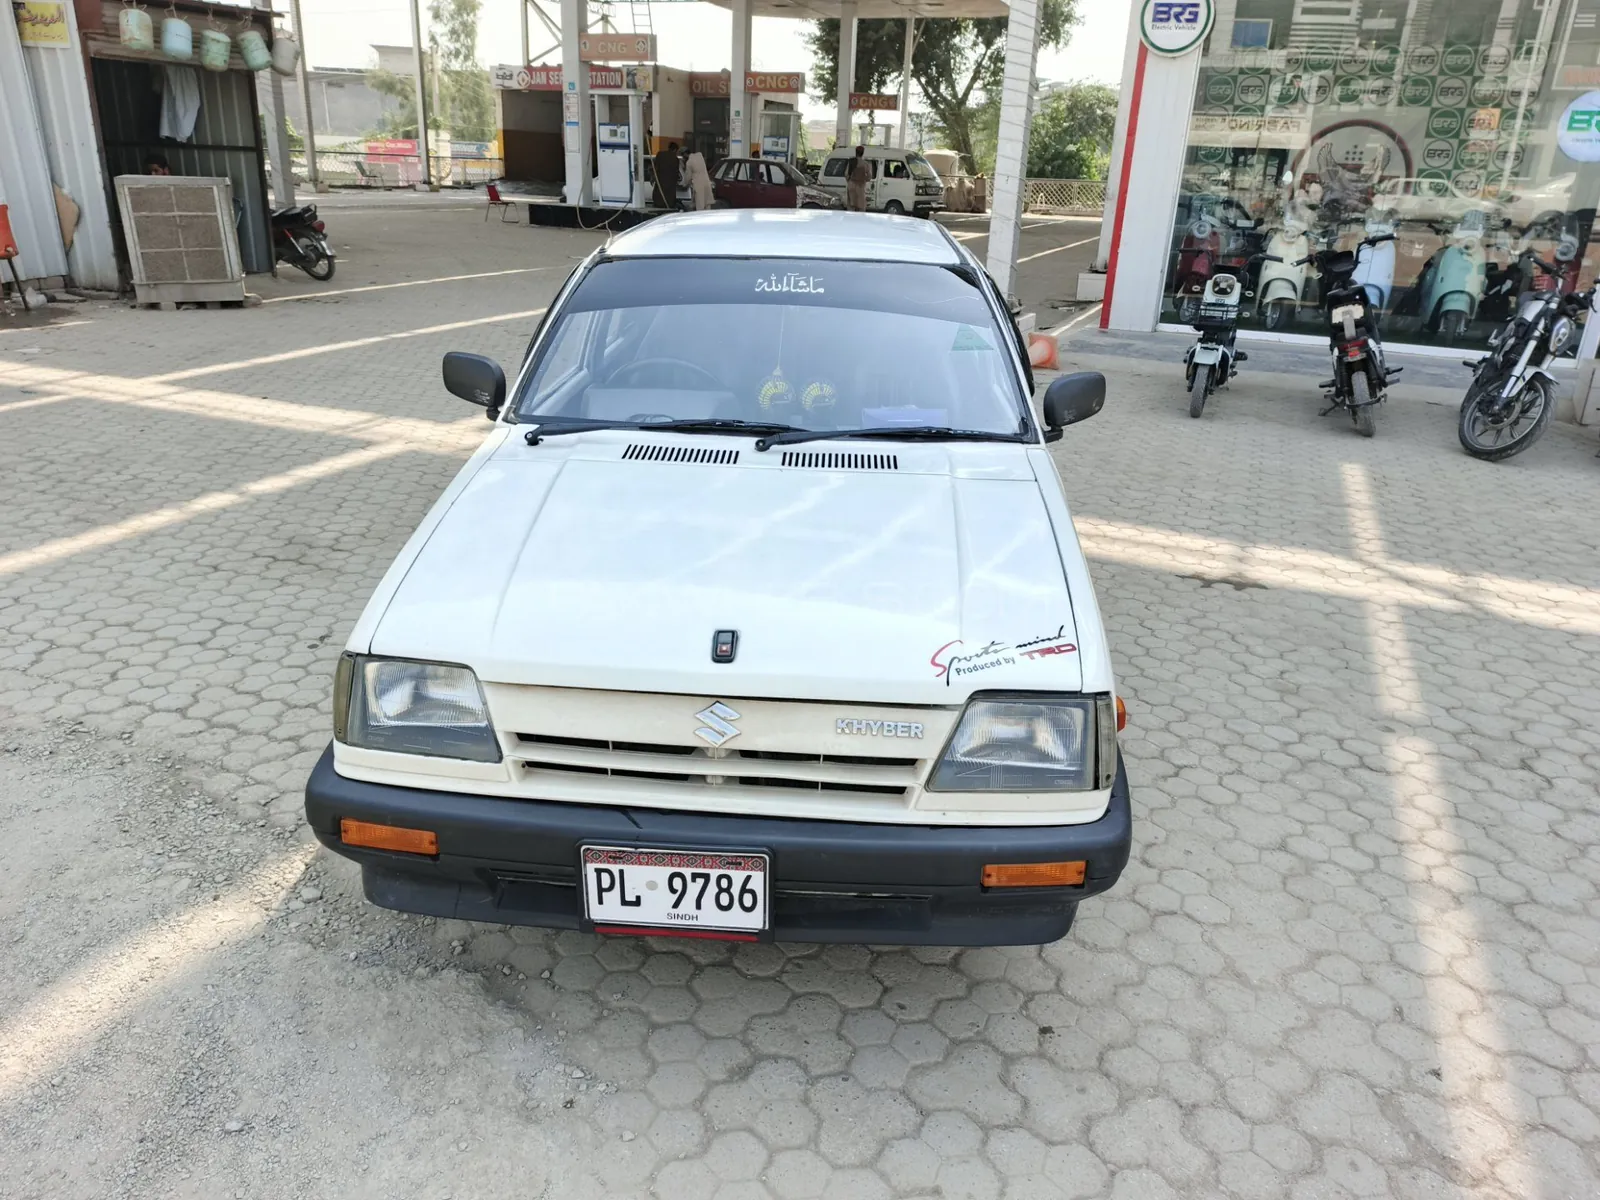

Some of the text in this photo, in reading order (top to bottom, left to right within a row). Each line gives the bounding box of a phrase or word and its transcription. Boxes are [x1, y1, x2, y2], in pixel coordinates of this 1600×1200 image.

[1152, 3, 1200, 23] BRG
[598, 42, 627, 53] CNG
[1446, 55, 1471, 64] BRG
[531, 71, 547, 85] JAN
[756, 75, 787, 89] CNG
[692, 81, 714, 93] OIL
[1240, 86, 1263, 94] BRG
[1439, 87, 1464, 96] BRG
[860, 96, 887, 108] CNG
[1431, 118, 1456, 128] BRG
[1426, 149, 1451, 158] BRG
[1015, 625, 1066, 649] mind
[955, 643, 1077, 676] Produced by TRD
[836, 719, 924, 739] KHYBER
[594, 868, 758, 913] PL 9786
[666, 912, 699, 922] SINDH
